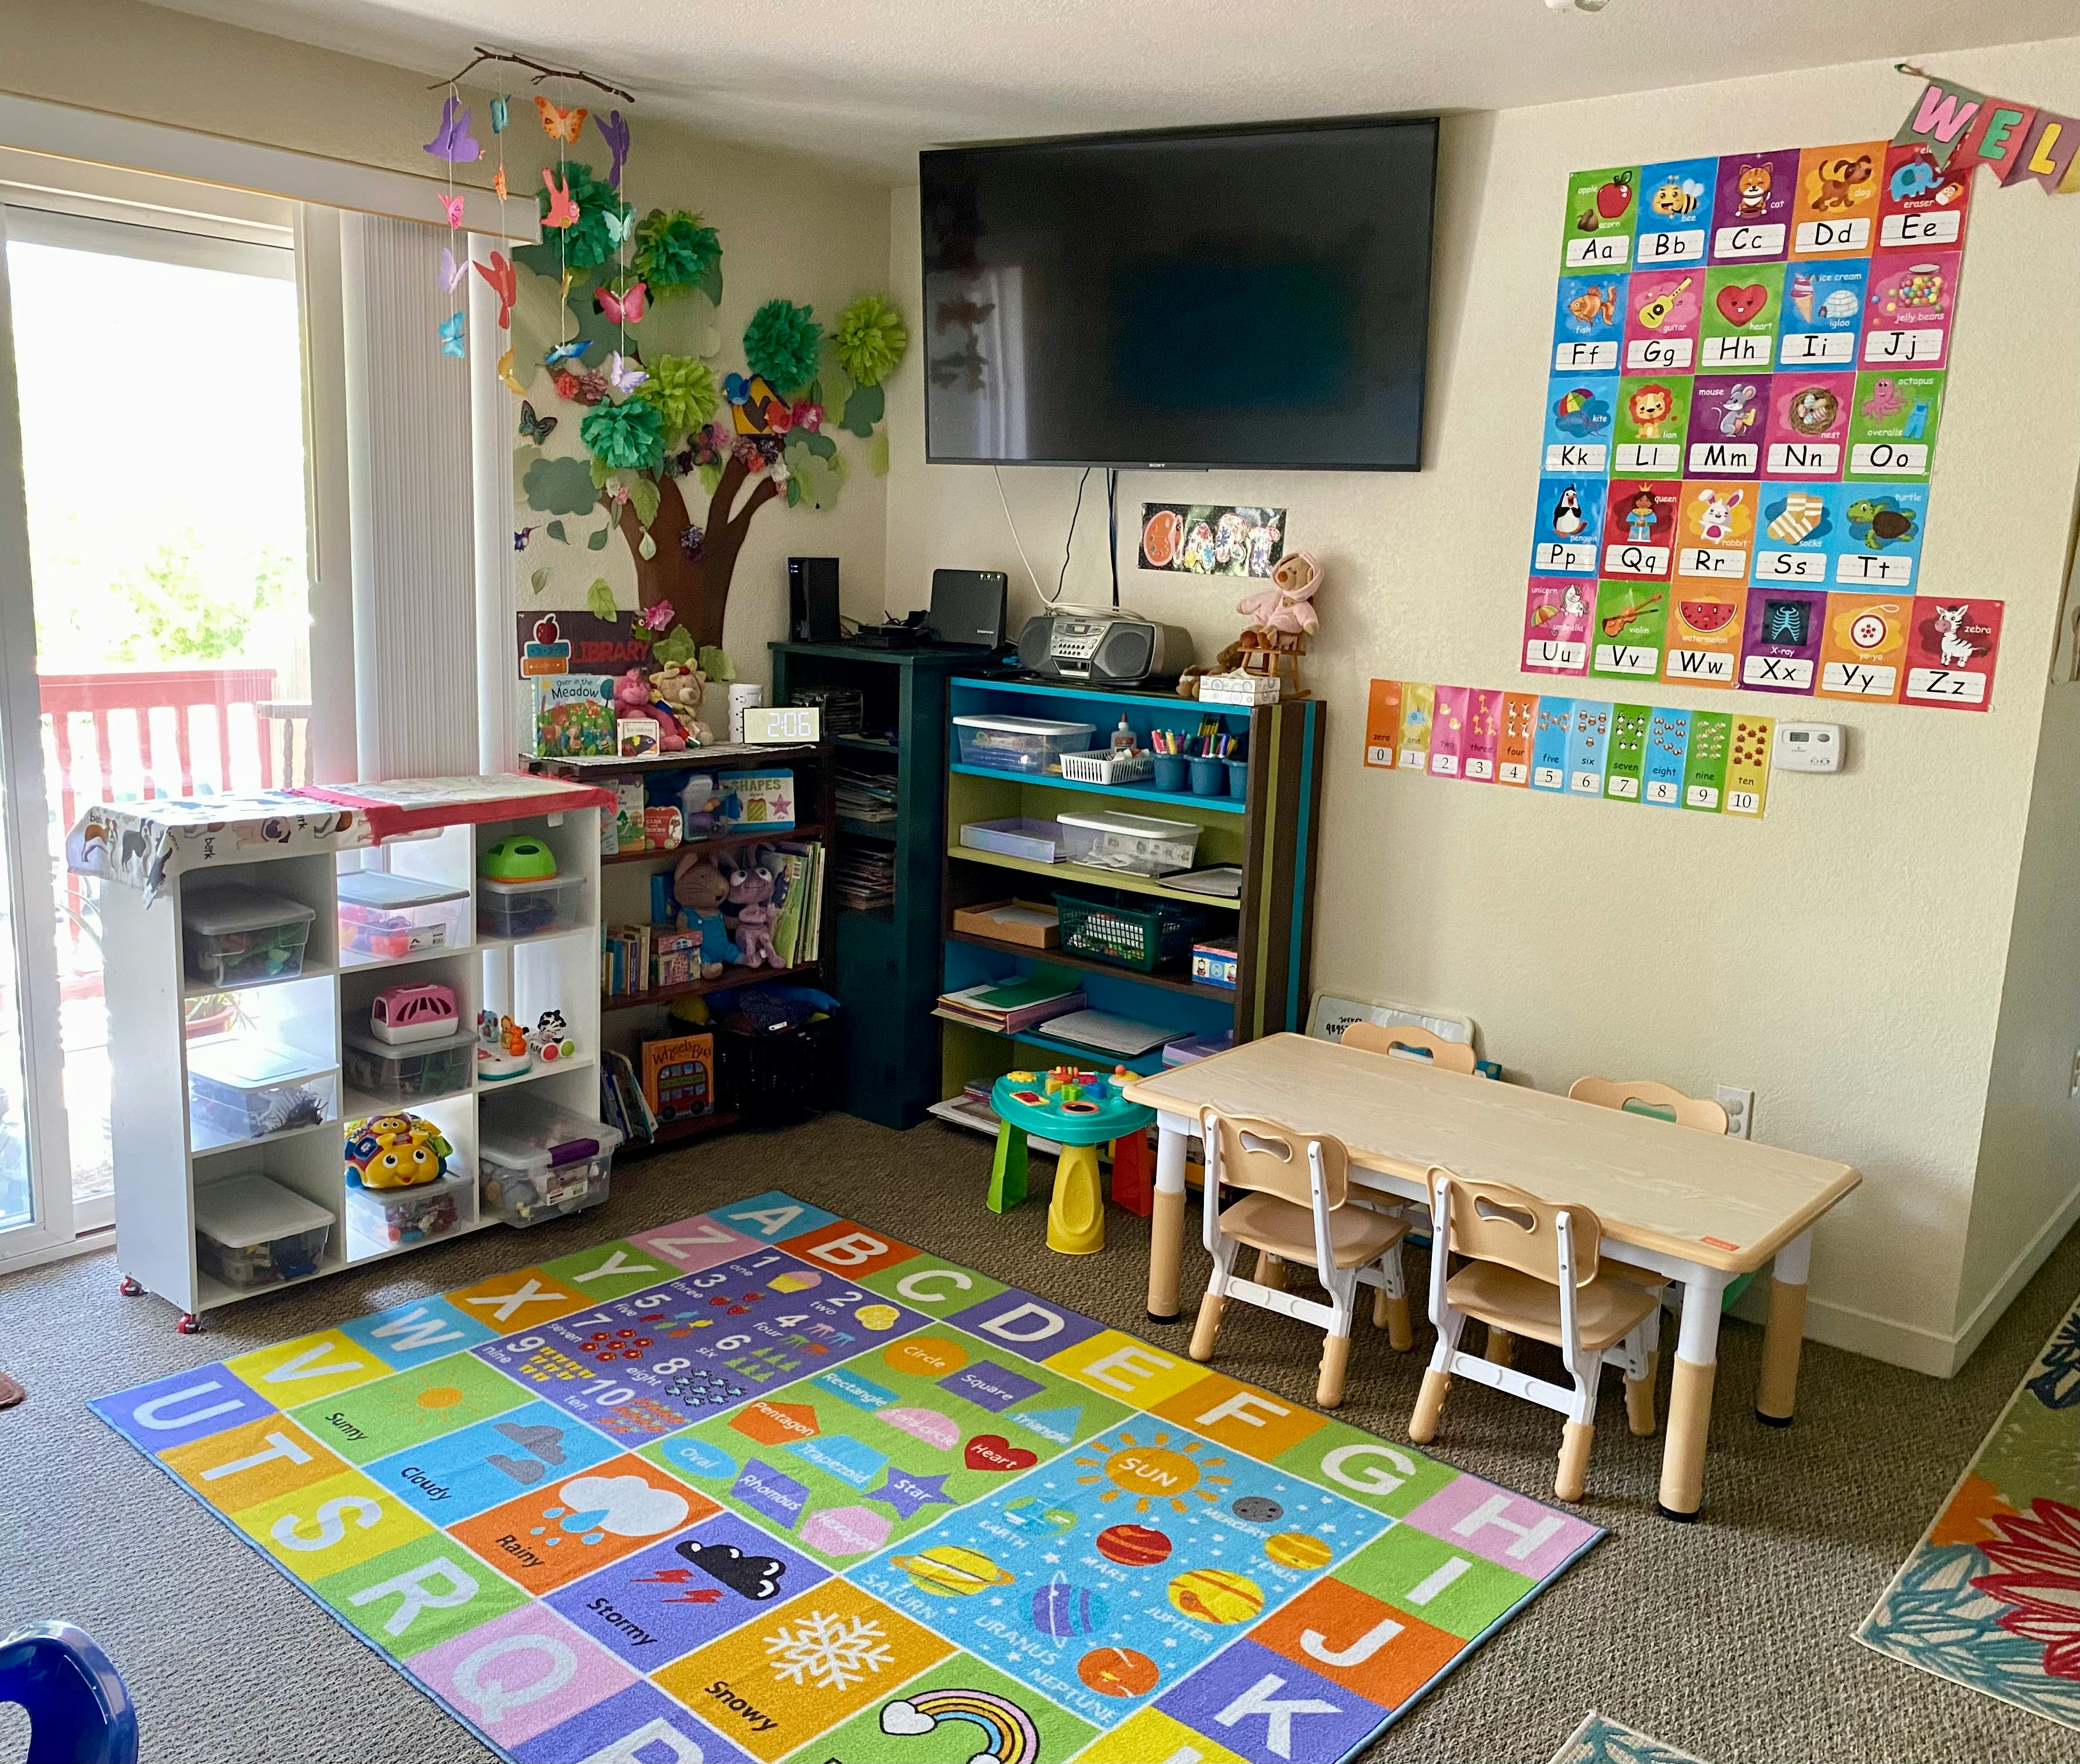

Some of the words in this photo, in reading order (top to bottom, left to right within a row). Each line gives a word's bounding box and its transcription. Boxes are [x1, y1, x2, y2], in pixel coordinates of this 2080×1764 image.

[1578, 185, 1598, 194] apple
[1854, 188, 1870, 197] dog
[1771, 200, 1784, 208] cat
[1904, 199, 1934, 209] eraser
[1599, 220, 1619, 229] acorn
[1815, 223, 1851, 245] Dd
[1902, 214, 1936, 238] Ee
[1655, 235, 1685, 255] Bb
[1732, 229, 1761, 249] Cc
[1583, 242, 1612, 259] Aa
[1819, 273, 1833, 281] ice
[1835, 272, 1861, 280] cream
[1663, 323, 1686, 332] guitar
[1829, 319, 1849, 328] igloo
[1895, 313, 1916, 323] jelly
[1919, 312, 1944, 320] beans
[1576, 325, 1590, 334] fish
[1572, 344, 1598, 365] Ff
[1644, 340, 1674, 366] Gg
[1720, 337, 1754, 360] Hh
[1803, 335, 1827, 356] Ii
[1885, 332, 1917, 360] Jj
[1898, 377, 1933, 387] octopus
[1593, 414, 1607, 422] kite
[1867, 428, 1902, 436] overalls
[1561, 447, 1587, 466] Kk
[1635, 447, 1657, 466] Ll
[1704, 446, 1746, 467] Mm
[1785, 446, 1822, 467] Nn
[1870, 445, 1908, 467] Oo
[1654, 496, 1676, 504] queen
[1895, 493, 1920, 502] turtle
[1570, 535, 1597, 543] penguin
[1722, 539, 1747, 547] rabbit
[1799, 539, 1822, 547] socks
[1550, 545, 1576, 568] Pp
[1622, 547, 1655, 573] Qq
[1695, 550, 1723, 571] Rr
[1775, 554, 1806, 574] Ss
[1858, 556, 1889, 578] Tt
[1629, 626, 1649, 635] violin
[1682, 634, 1728, 644] watermelon
[1965, 625, 1991, 635] zebra
[572, 641, 650, 663] LIBRARY
[1543, 642, 1570, 663] Uu
[1611, 646, 1639, 667] Vv
[1770, 646, 1794, 657] X-ray
[1859, 652, 1882, 661] yo-yo
[1680, 651, 1722, 675] Ww
[1763, 659, 1795, 681] Xx
[1842, 665, 1873, 689] Yy
[1930, 670, 1964, 695] Zz
[552, 684, 598, 699] Meadow
[767, 712, 811, 737] 2:06
[1376, 751, 1385, 762] 0
[1409, 752, 1415, 764] 1
[1470, 744, 1492, 753] three
[1507, 747, 1524, 756] four
[1543, 754, 1559, 763] five
[1441, 757, 1449, 768] 2
[1476, 761, 1483, 773] 3
[1613, 761, 1638, 771] seven
[1653, 767, 1676, 778] eight
[1509, 767, 1518, 779] 4
[1545, 770, 1553, 783] 5
[1583, 776, 1590, 788] 6
[1695, 772, 1715, 781] nine
[1739, 777, 1754, 785] ten
[731, 779, 781, 792] SHAPES
[1619, 779, 1628, 792] 7
[1658, 785, 1666, 798] 8
[1699, 789, 1707, 802] 9
[1734, 793, 1752, 808] 10
[204, 838, 215, 860] bark
[653, 1041, 692, 1065] Wheels
[729, 1205, 804, 1235] A
[648, 1226, 736, 1260] Z
[807, 1232, 888, 1264] B
[573, 1250, 657, 1282] Y
[730, 1264, 753, 1276] one
[753, 1257, 780, 1267] 1
[670, 1281, 703, 1299] three
[694, 1274, 727, 1288] 3
[897, 1270, 972, 1302] C
[466, 1279, 567, 1321] X
[635, 1294, 672, 1308] 5
[811, 1301, 836, 1315] two
[826, 1291, 863, 1307] 2
[613, 1303, 637, 1317] five
[371, 1308, 465, 1351] W
[572, 1314, 612, 1328] 7
[753, 1322, 783, 1337] four
[776, 1315, 809, 1328] 4
[978, 1302, 1064, 1342] D
[548, 1322, 583, 1343] seven
[716, 1335, 751, 1350] 6
[507, 1337, 545, 1352] 9
[695, 1346, 718, 1358] six
[262, 1342, 364, 1385] V
[482, 1346, 512, 1364] nine
[903, 1346, 946, 1369] Circle
[653, 1358, 691, 1374] 8
[1081, 1346, 1176, 1391] E
[626, 1367, 663, 1387] eight
[581, 1380, 635, 1405] 10
[822, 1373, 887, 1407] Rectangle
[961, 1374, 1013, 1402] Square
[134, 1382, 245, 1430] U
[563, 1395, 588, 1411] ten
[1195, 1392, 1290, 1428] F
[326, 1412, 367, 1441] Sunny
[752, 1402, 814, 1436] Pentagon
[200, 1434, 312, 1481] T
[680, 1448, 719, 1469] Oval
[970, 1443, 1016, 1470] Heart
[1119, 1458, 1178, 1487] SUN
[1321, 1444, 1416, 1495] G
[401, 1467, 452, 1502] Cloudy
[740, 1475, 802, 1510] Rhombus
[894, 1479, 932, 1500] Star
[272, 1496, 381, 1551] S
[978, 1520, 1026, 1547] EARTH
[1451, 1495, 1567, 1560] H
[496, 1534, 544, 1568] Rainy
[1081, 1557, 1128, 1583] MARS
[1249, 1556, 1300, 1583] VENUS
[1406, 1557, 1472, 1606] I
[350, 1557, 478, 1637] R
[861, 1574, 937, 1621] SATURN
[587, 1599, 658, 1647] Stormy
[975, 1615, 1059, 1666] URANUS
[1300, 1619, 1406, 1666] J
[452, 1634, 577, 1724] Q
[1028, 1668, 1115, 1723] NEPTUNE
[705, 1680, 776, 1732] Snowy
[1213, 1673, 1344, 1759] K
